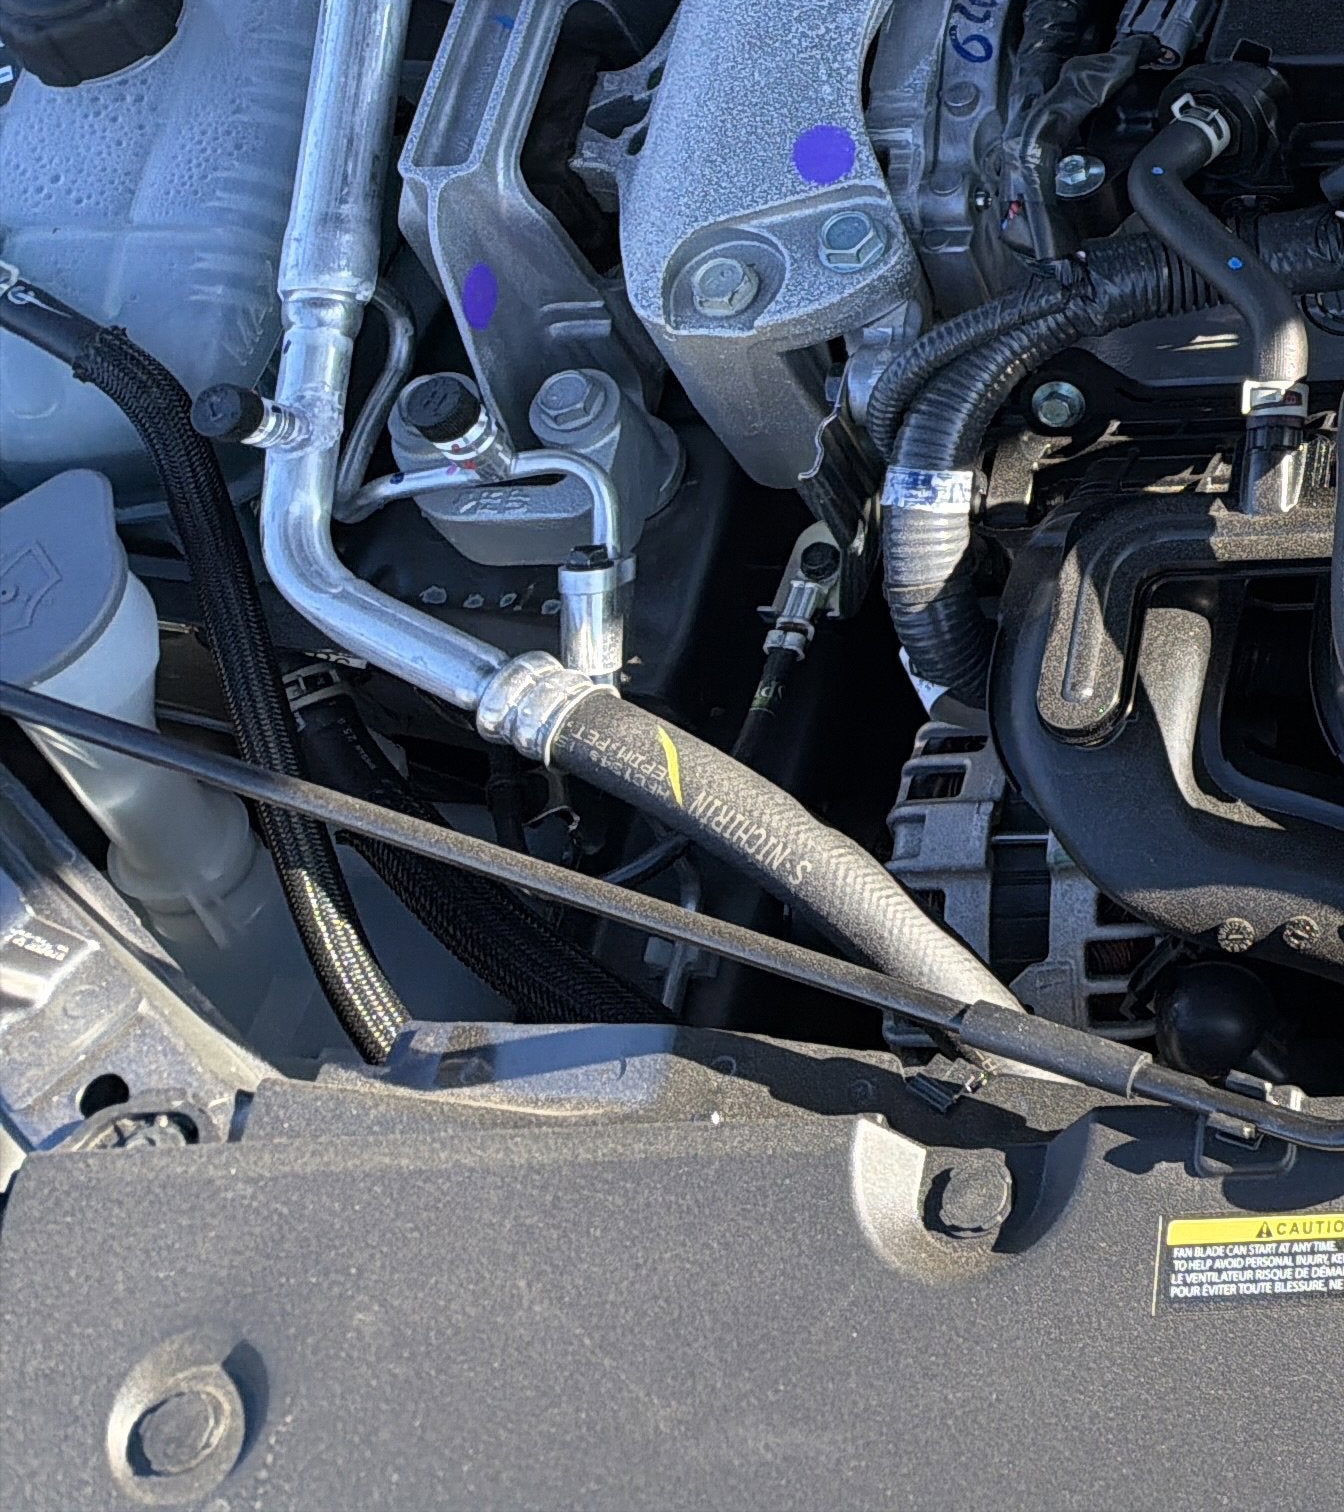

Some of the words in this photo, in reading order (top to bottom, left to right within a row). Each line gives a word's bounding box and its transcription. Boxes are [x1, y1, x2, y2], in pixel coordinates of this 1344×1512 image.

[1173, 1246, 1193, 1258] FAN
[1194, 1244, 1225, 1257] BLADE
[1226, 1243, 1247, 1256] CAN
[1249, 1242, 1277, 1255] START
[1278, 1242, 1291, 1254] AT
[1173, 1258, 1187, 1272] TO
[1188, 1257, 1213, 1271] HELP
[1214, 1256, 1244, 1269] AVOID
[1245, 1254, 1294, 1268] PERSONAL
[1296, 1253, 1329, 1267] INJURY,
[1170, 1273, 1185, 1285] LE
[1186, 1269, 1254, 1284] VENTILATEUR
[1255, 1268, 1293, 1282] RISQUE
[1294, 1267, 1310, 1279] DE
[1170, 1285, 1200, 1298] POUR
[1201, 1282, 1237, 1297] ÉVITER
[1238, 1282, 1273, 1295] TOUTE
[1329, 1279, 1344, 1291] NE
